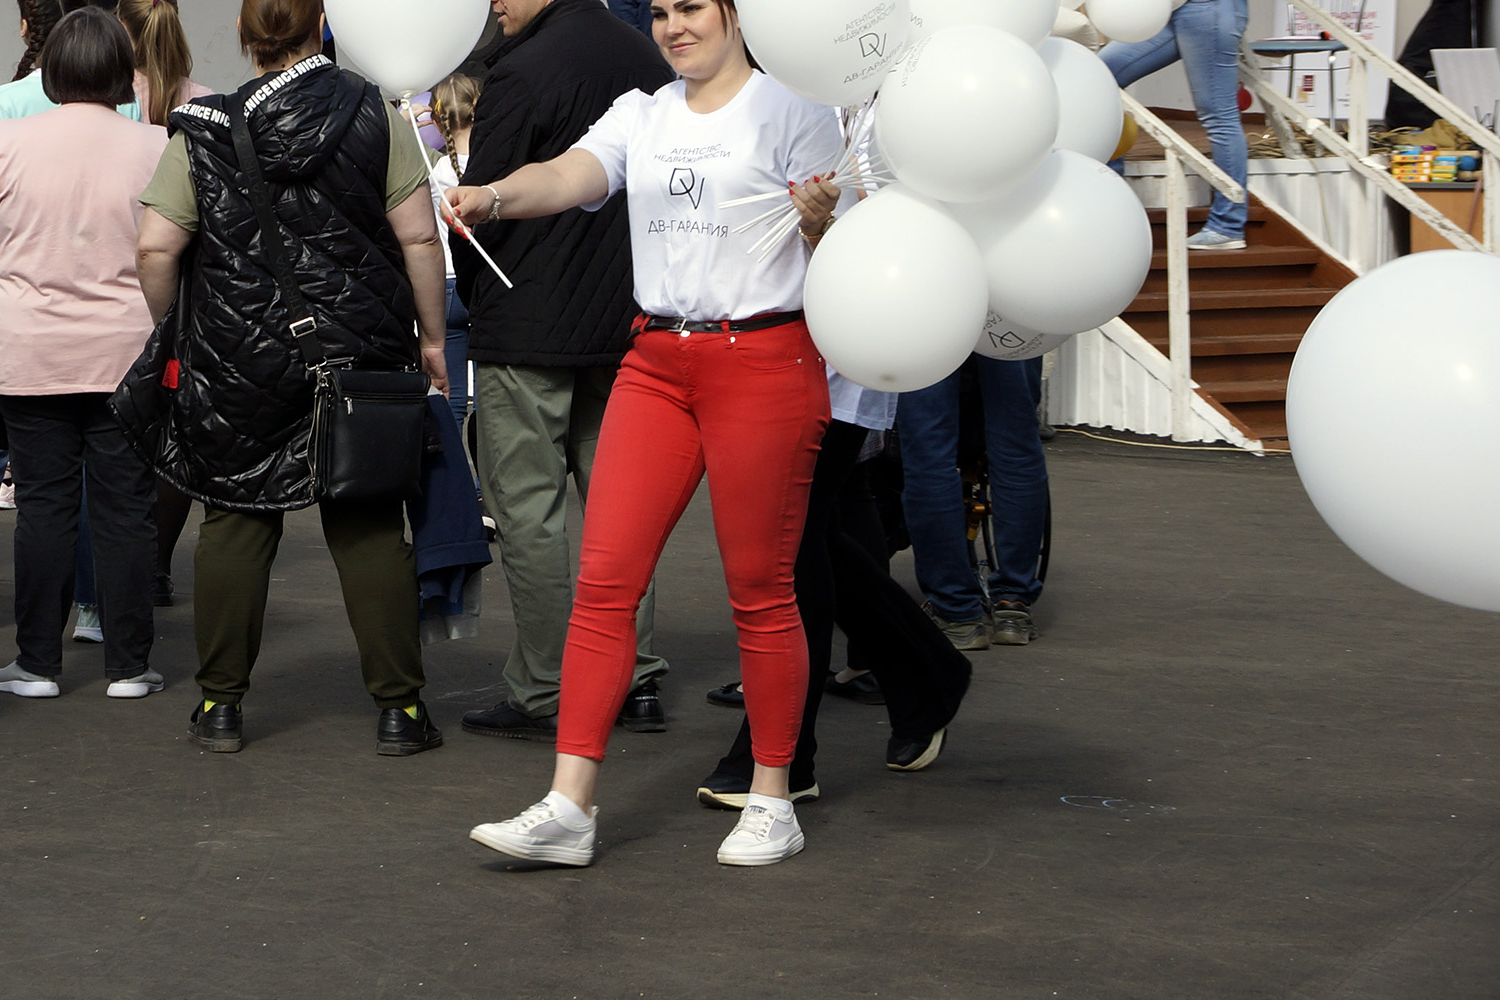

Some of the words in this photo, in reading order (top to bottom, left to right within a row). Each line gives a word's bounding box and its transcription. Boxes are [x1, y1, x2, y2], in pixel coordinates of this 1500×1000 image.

[845, 2, 886, 32] АГЕНТСТВО
[670, 143, 722, 155] АГЕНТСТВО
[653, 151, 732, 164] НЕДВИЖИМОСТИ
[648, 219, 729, 239] ДВ-ГАРАНТИЯ
